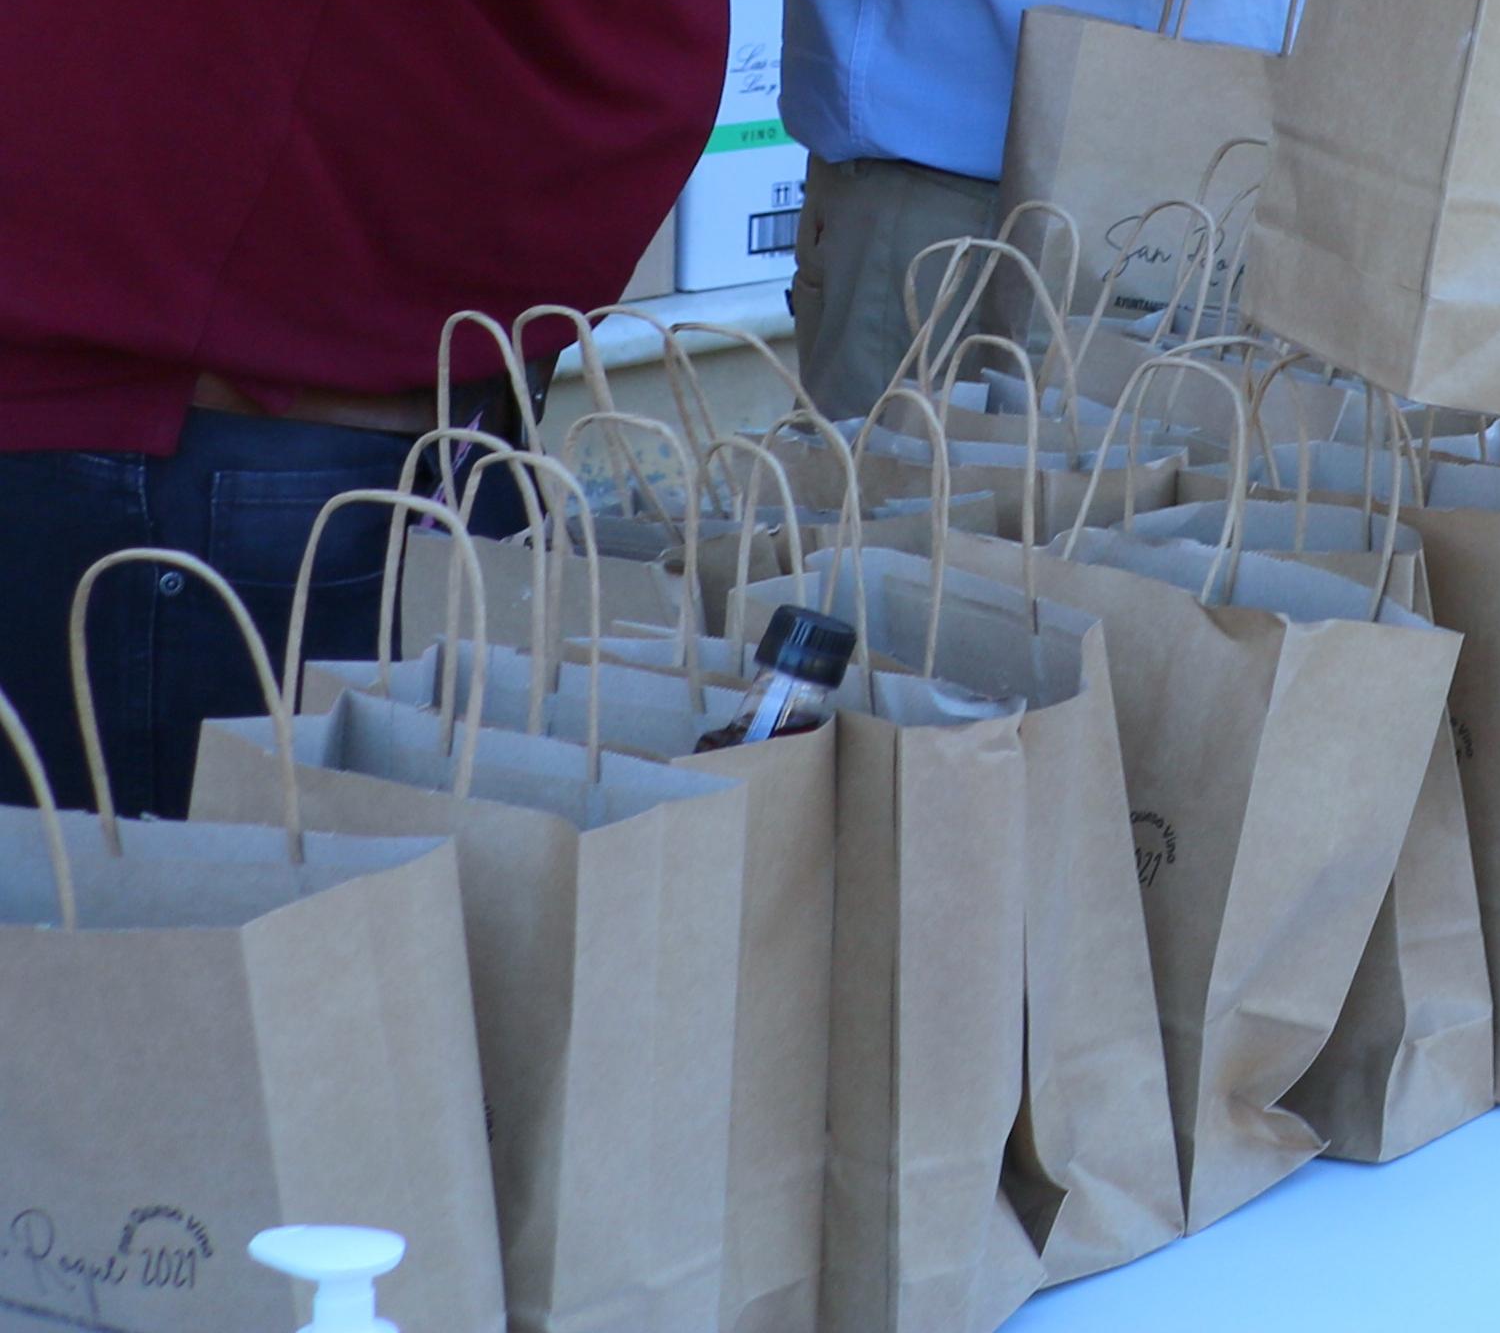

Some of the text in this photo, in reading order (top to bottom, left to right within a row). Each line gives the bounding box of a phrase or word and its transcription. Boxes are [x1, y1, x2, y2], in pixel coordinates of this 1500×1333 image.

[740, 127, 778, 143] VINO
[1102, 215, 1172, 283] San
[1163, 823, 1177, 865] Vino
[185, 1213, 214, 1259] Vino
[142, 1247, 198, 1289] 2021
